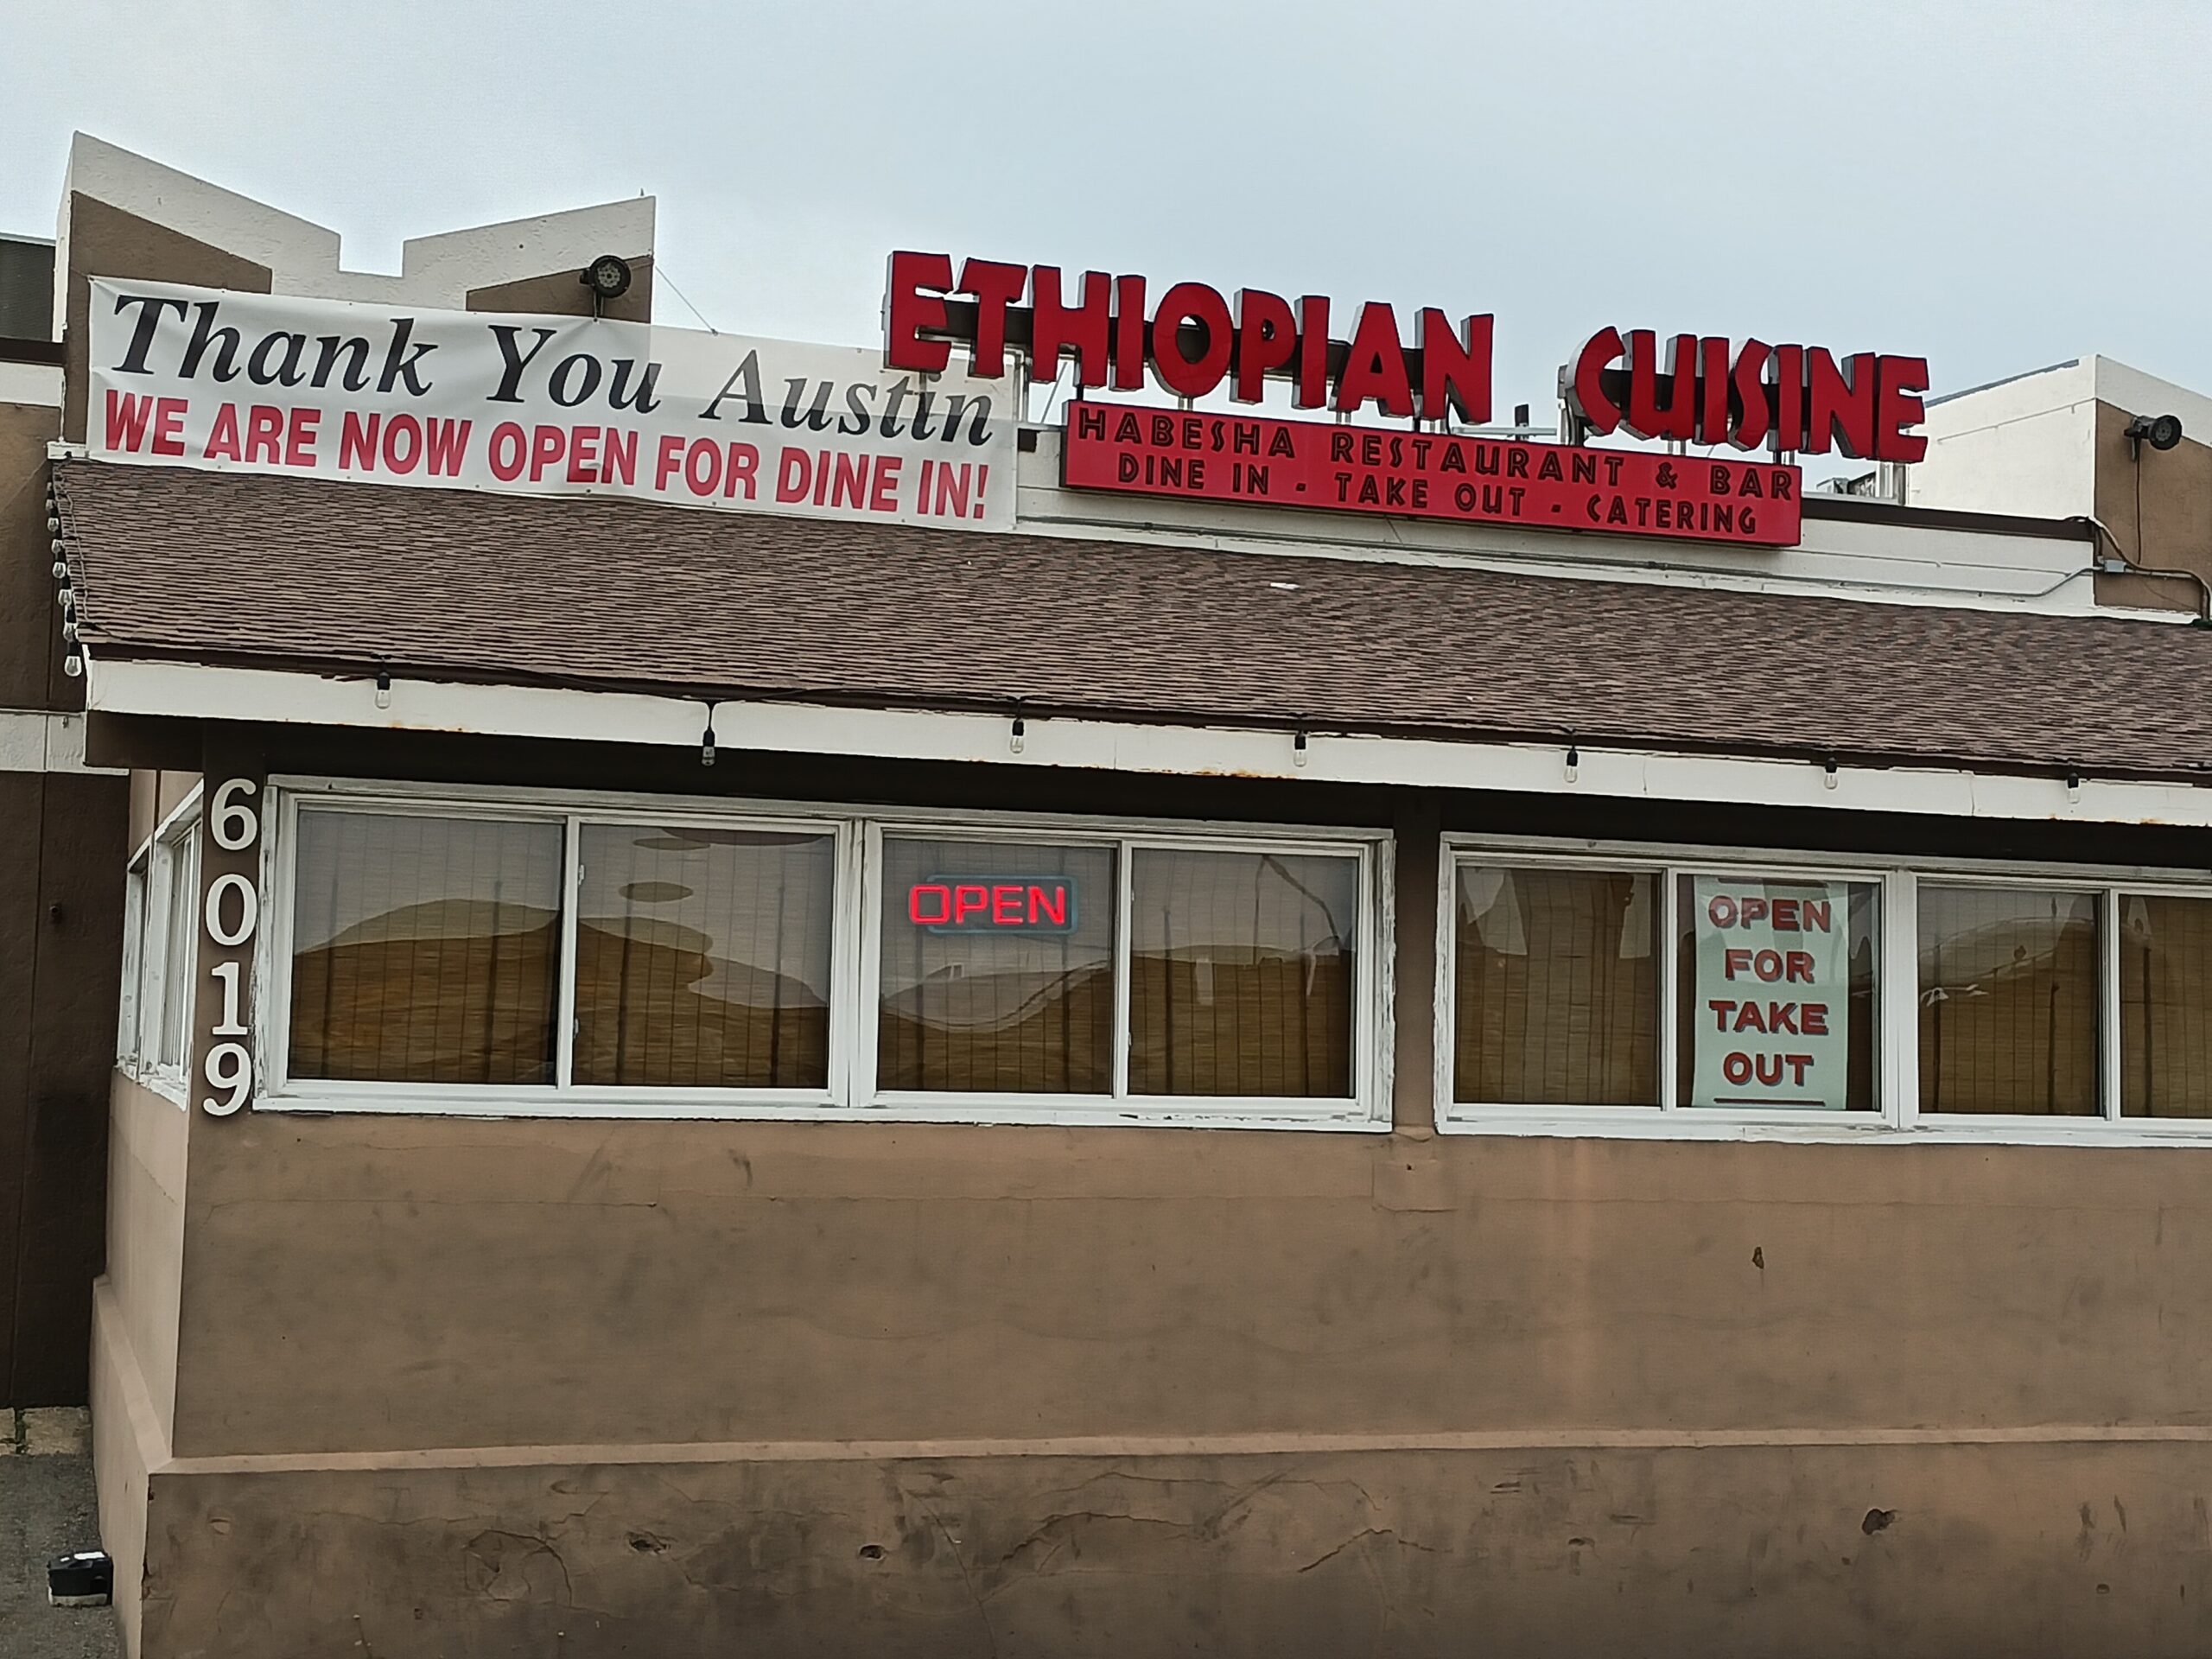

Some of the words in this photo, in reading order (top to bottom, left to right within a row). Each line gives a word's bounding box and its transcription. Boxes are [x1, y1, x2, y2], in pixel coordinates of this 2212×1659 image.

[112, 295, 438, 397] Thank
[486, 325, 662, 414] You
[698, 349, 994, 446] Austin
[886, 251, 1494, 424] ETHIOPIAN
[1568, 326, 1930, 463] CUISINE
[105, 389, 188, 456] WE
[203, 403, 321, 467] ARE
[339, 411, 472, 477] NOW
[488, 422, 638, 486] OPEN
[655, 435, 760, 500] FOR
[776, 446, 902, 512] DINE
[917, 459, 989, 519] IN!
[1078, 408, 1295, 459] HABESHA
[1331, 432, 1624, 486] RESTAURANT
[1656, 462, 1677, 489] &
[1710, 465, 1793, 500] BAR
[1118, 452, 1205, 489] DINE
[1232, 463, 1269, 495] IN
[1335, 473, 1428, 509] TAKE
[1454, 483, 1525, 517] OUT
[1586, 493, 1756, 534] CATERING
[909, 884, 1065, 925] OPEN
[1708, 894, 1832, 933] OPEN
[203, 779, 257, 1116] 6019
[1725, 949, 1815, 983] FOR
[1708, 1000, 1829, 1036] TAKE
[1723, 1052, 1814, 1086] OUT
